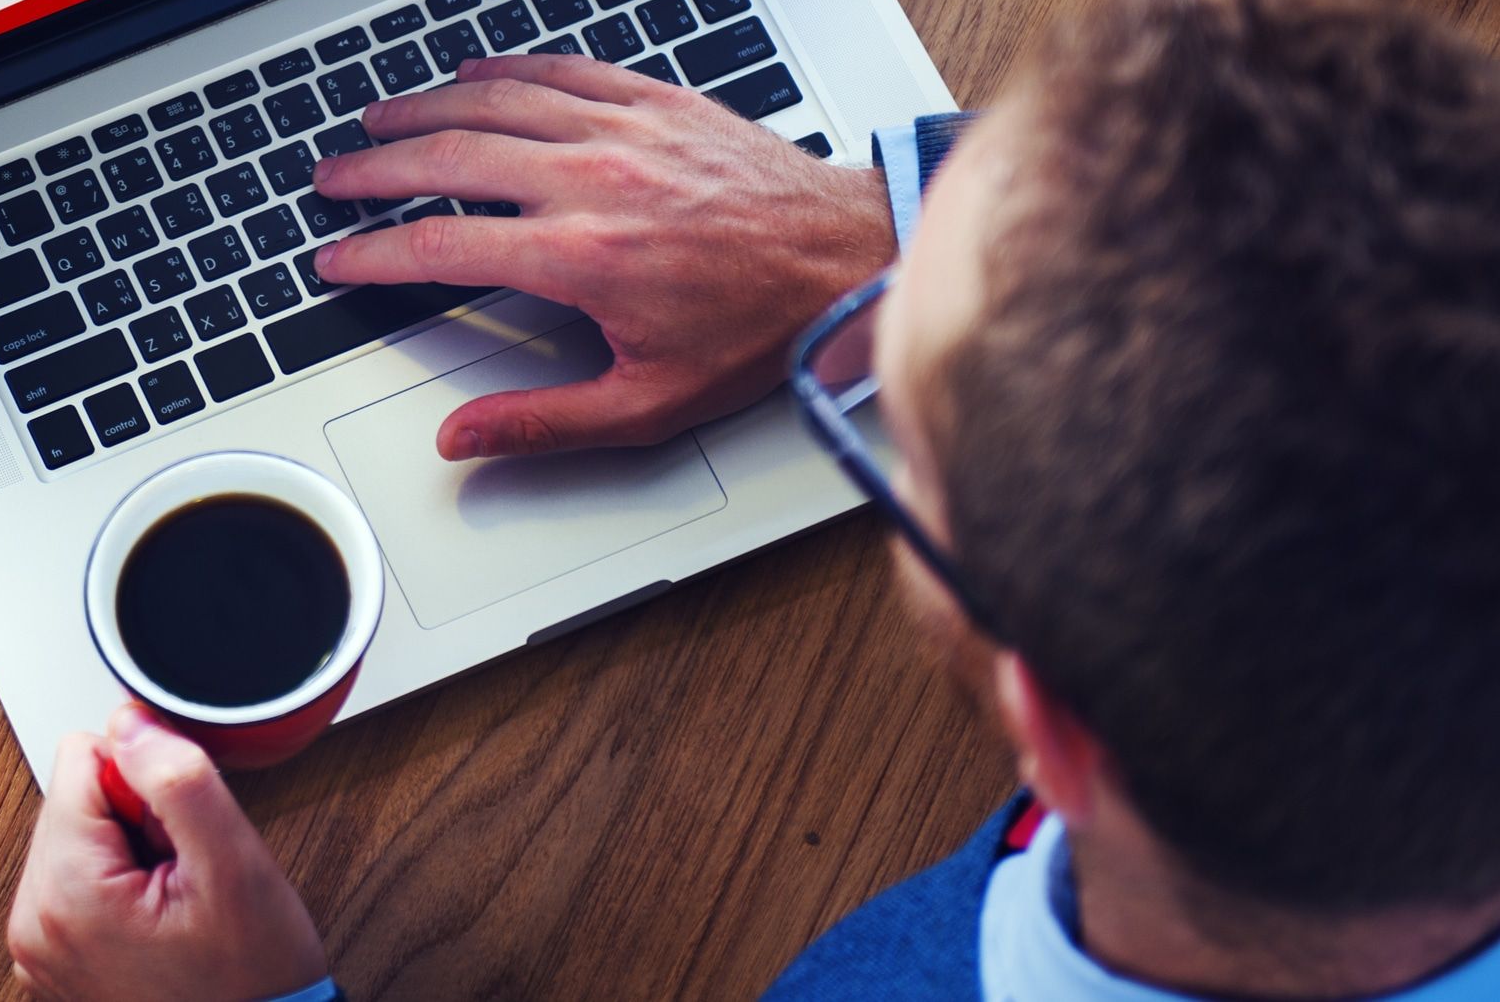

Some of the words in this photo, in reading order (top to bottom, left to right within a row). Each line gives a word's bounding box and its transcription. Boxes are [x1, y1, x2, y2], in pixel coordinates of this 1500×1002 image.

[732, 22, 753, 35] enter
[441, 51, 449, 62] 9
[738, 43, 768, 61] return
[327, 79, 338, 89] &
[388, 73, 397, 84] 8
[333, 93, 340, 105] 7
[770, 88, 790, 102] shift
[217, 121, 231, 132] %
[281, 116, 289, 126] 6
[226, 136, 235, 148] 5
[164, 143, 173, 154] $
[173, 158, 181, 168] 4
[111, 165, 118, 175] #
[275, 172, 284, 183] T
[117, 180, 127, 191] 3
[221, 194, 233, 206] R
[63, 202, 73, 213] 2
[166, 216, 177, 228] E
[314, 214, 326, 226] G
[8, 224, 15, 234] 1
[112, 235, 127, 249] W
[258, 236, 266, 248] F
[58, 259, 72, 270] Q
[204, 258, 216, 270] D
[150, 280, 160, 292] S
[256, 295, 268, 307] C
[97, 302, 108, 314] A
[201, 316, 214, 330] X
[3, 335, 28, 351] caps
[27, 330, 47, 342] lock
[145, 338, 158, 352] Z
[148, 378, 158, 386] alt
[26, 387, 46, 401] shift
[161, 398, 193, 416] option
[105, 417, 139, 439] control
